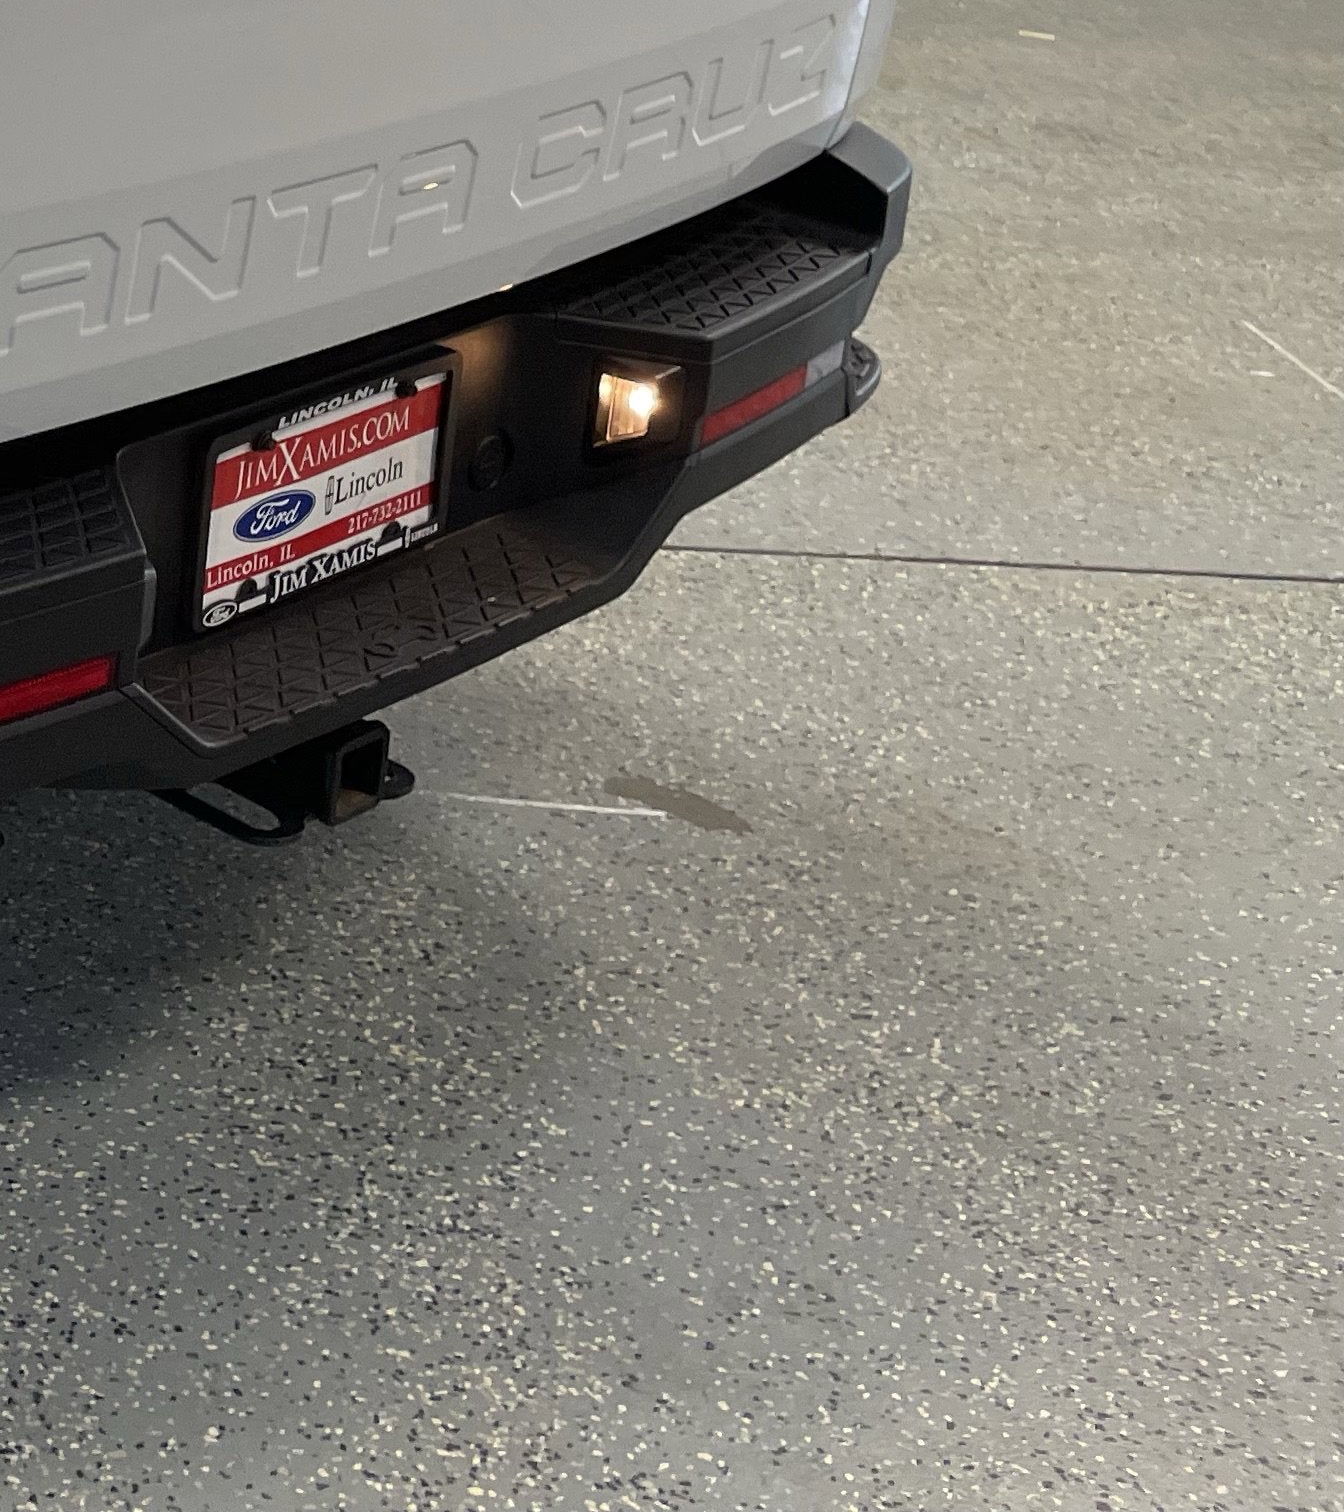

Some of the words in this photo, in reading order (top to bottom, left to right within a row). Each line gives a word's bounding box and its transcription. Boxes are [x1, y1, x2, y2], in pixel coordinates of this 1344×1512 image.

[509, 12, 838, 210] CRUZ
[278, 385, 374, 430] LINCOLN,
[234, 405, 410, 500] JIMXAMIS.COM
[334, 457, 404, 505] Lincoln
[250, 498, 301, 535] Ford
[347, 491, 422, 534] 217-732-2111
[206, 551, 274, 589] Lincoln,
[279, 546, 296, 563] IL
[270, 571, 307, 603] JIM
[311, 541, 378, 584] XAMIS
